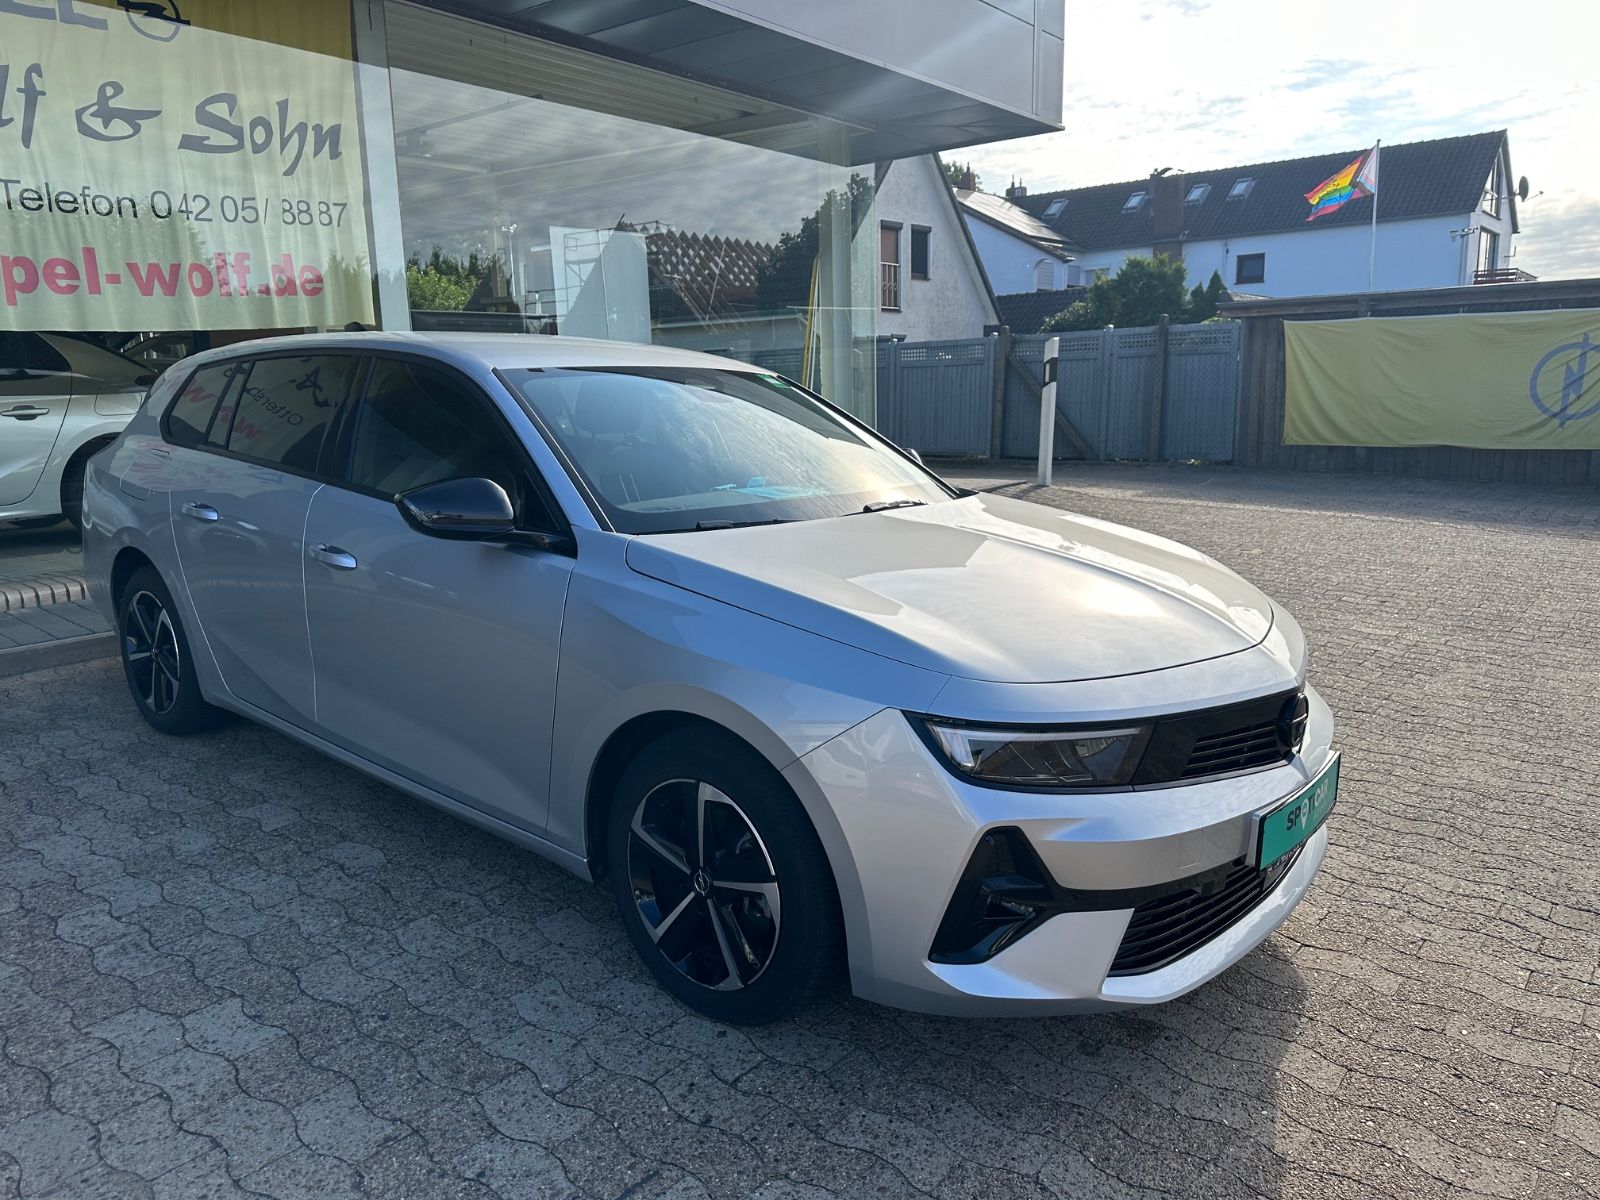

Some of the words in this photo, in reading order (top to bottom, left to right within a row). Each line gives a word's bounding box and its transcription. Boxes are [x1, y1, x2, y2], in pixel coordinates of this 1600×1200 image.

[75, 80, 162, 142] &
[178, 92, 342, 176] Sohn
[0, 178, 138, 218] Telefon
